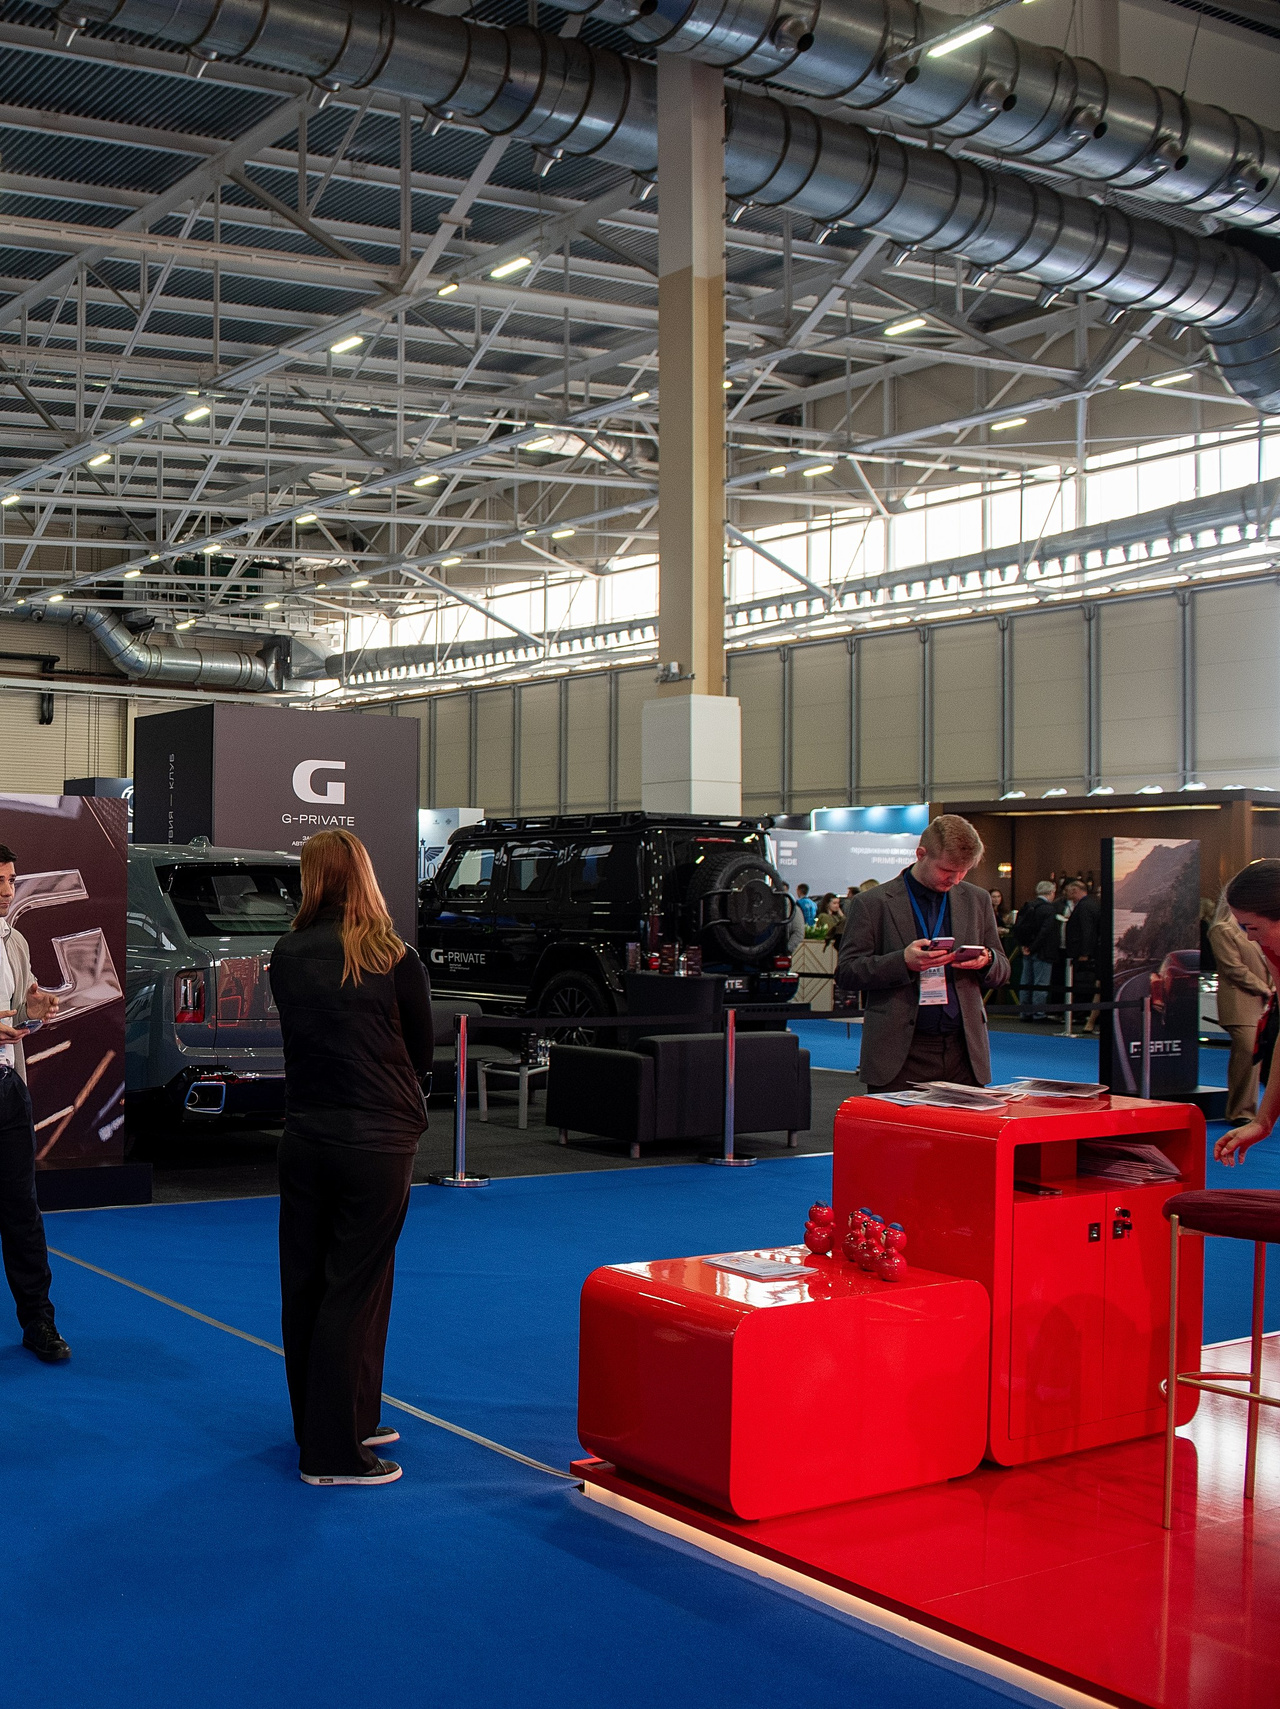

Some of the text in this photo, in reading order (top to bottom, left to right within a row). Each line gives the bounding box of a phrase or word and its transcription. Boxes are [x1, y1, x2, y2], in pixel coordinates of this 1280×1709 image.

[292, 759, 346, 805] G
[281, 813, 356, 827] G-PRIVATE
[430, 948, 486, 965] G-PRIVATE
